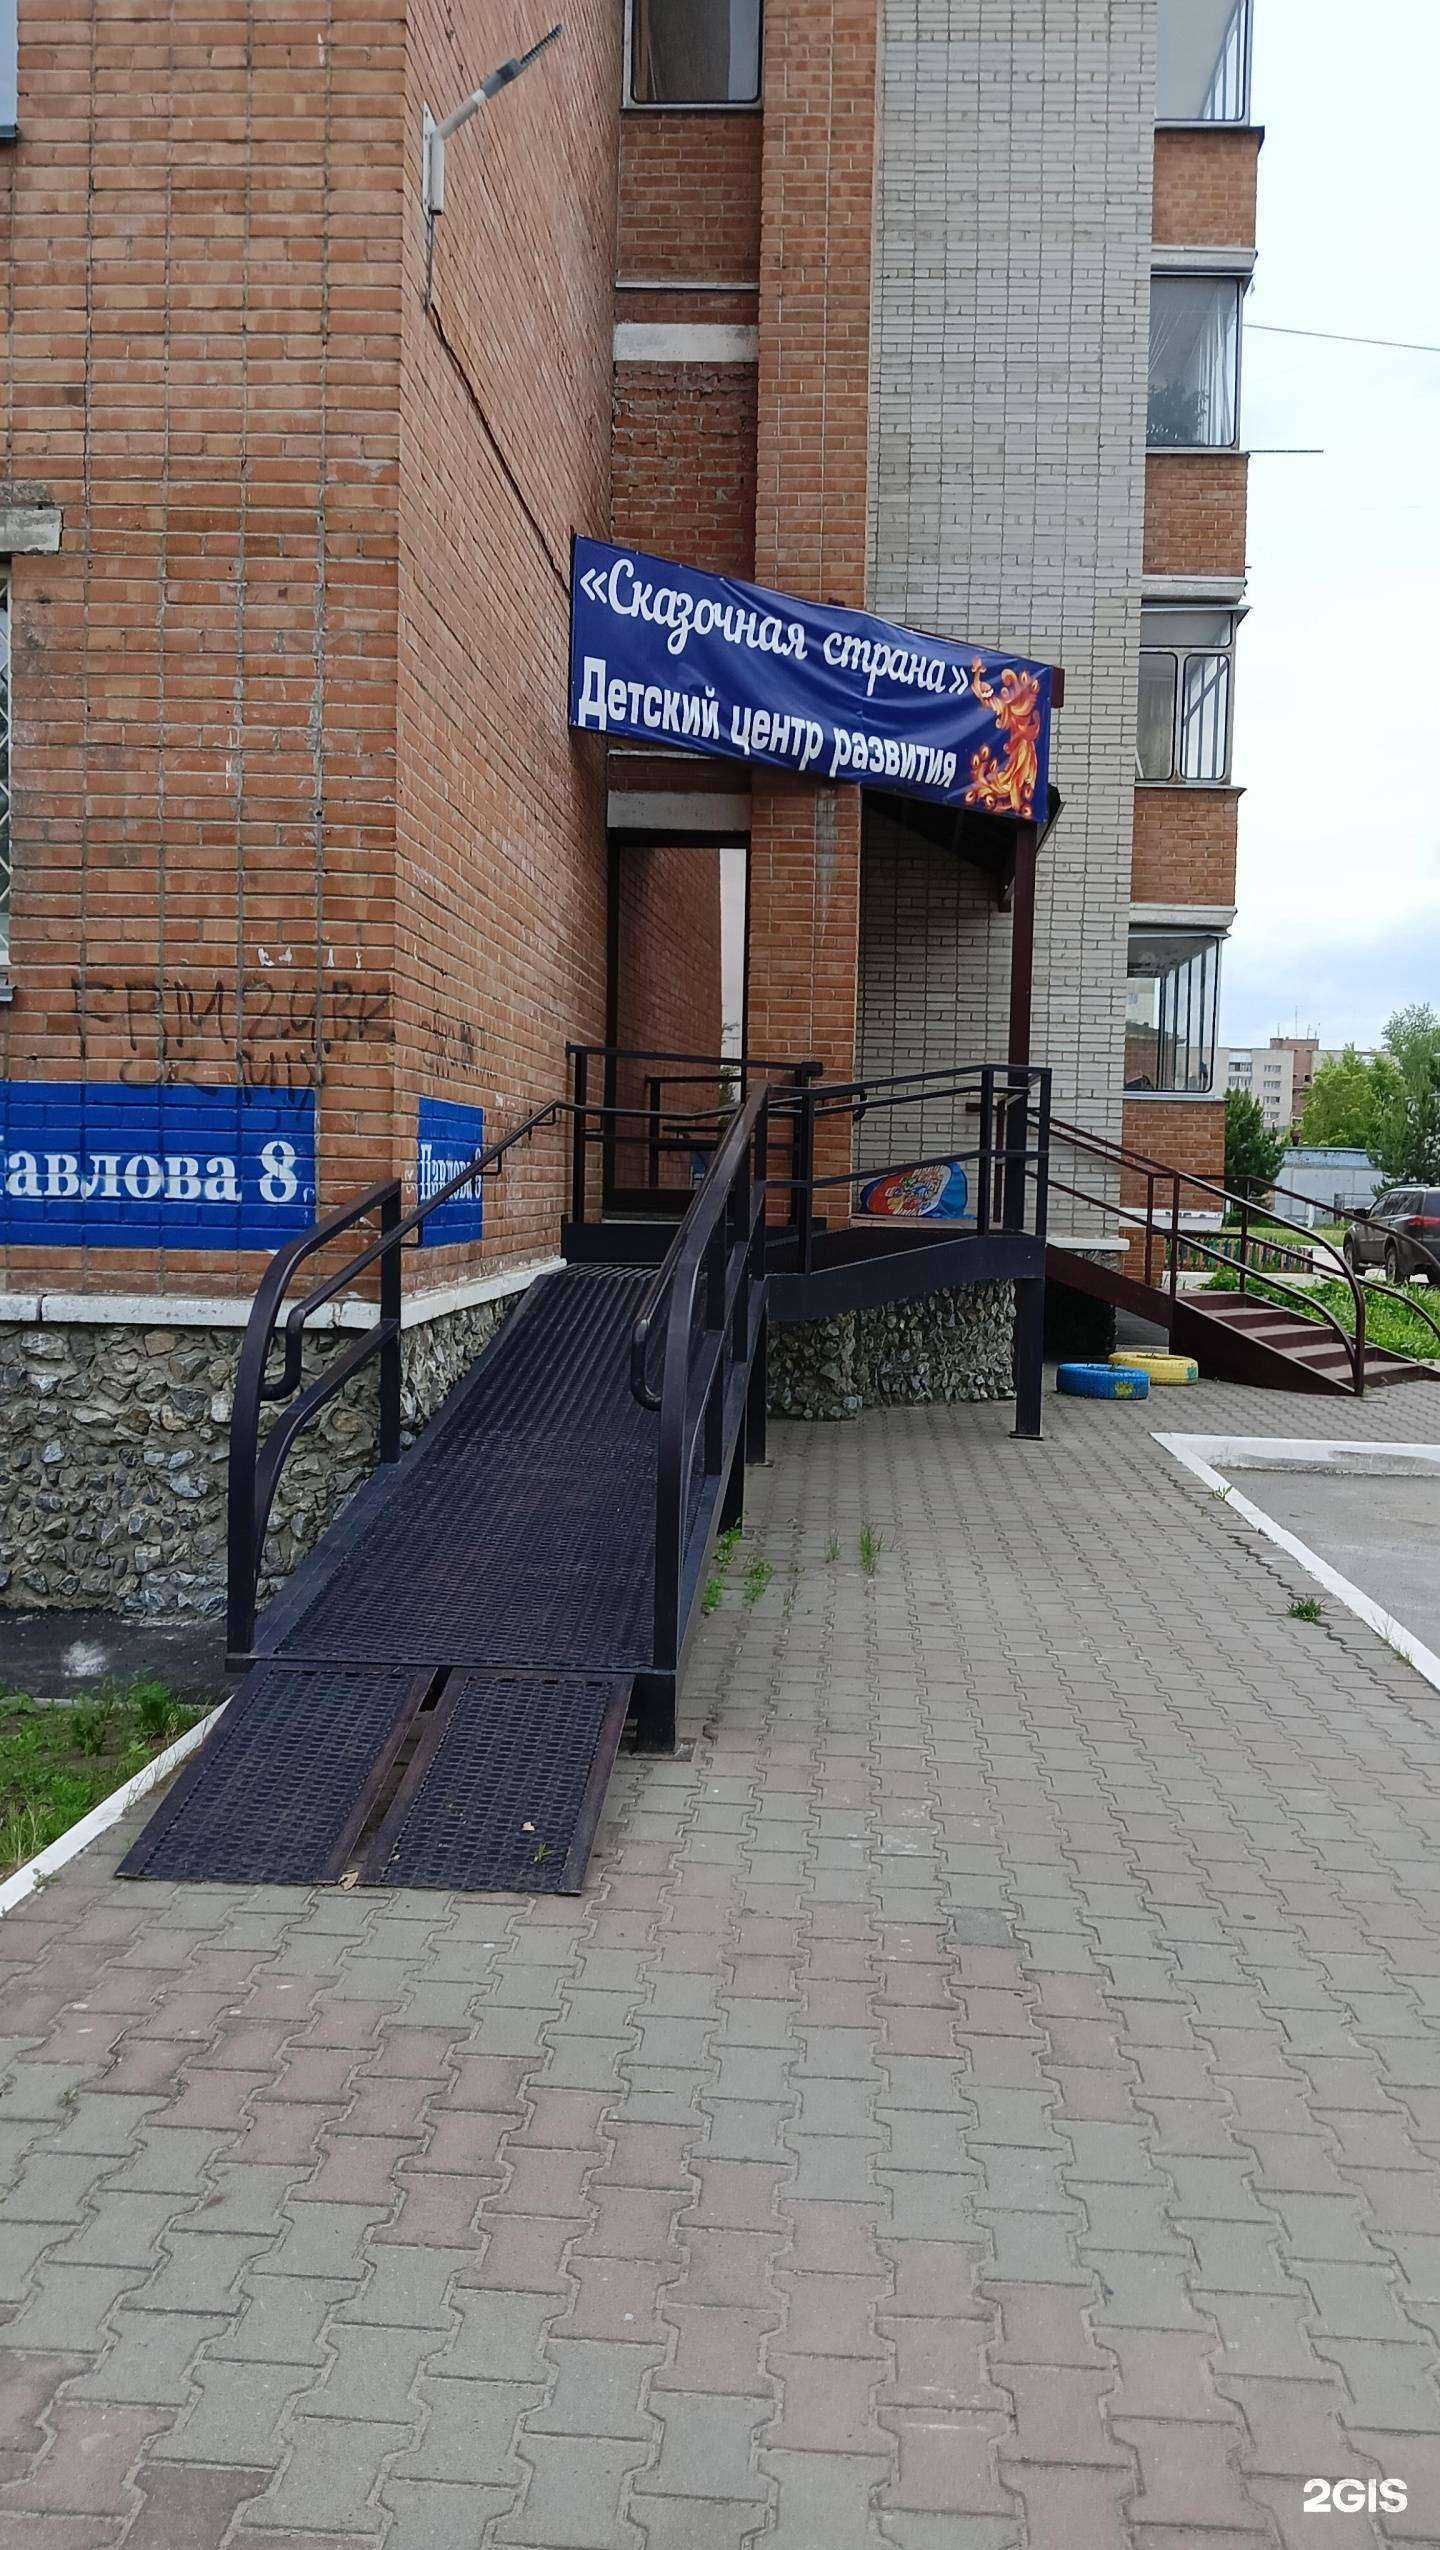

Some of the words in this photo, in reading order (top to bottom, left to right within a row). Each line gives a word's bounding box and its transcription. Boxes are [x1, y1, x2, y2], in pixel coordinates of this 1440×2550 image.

[579, 558, 808, 659] «Сказочная
[822, 632, 969, 696] страна»
[578, 656, 720, 740] Детский
[730, 705, 824, 771] центр
[829, 727, 957, 788] развития
[0, 1150, 242, 1201] авлова
[259, 1140, 298, 1202] 8
